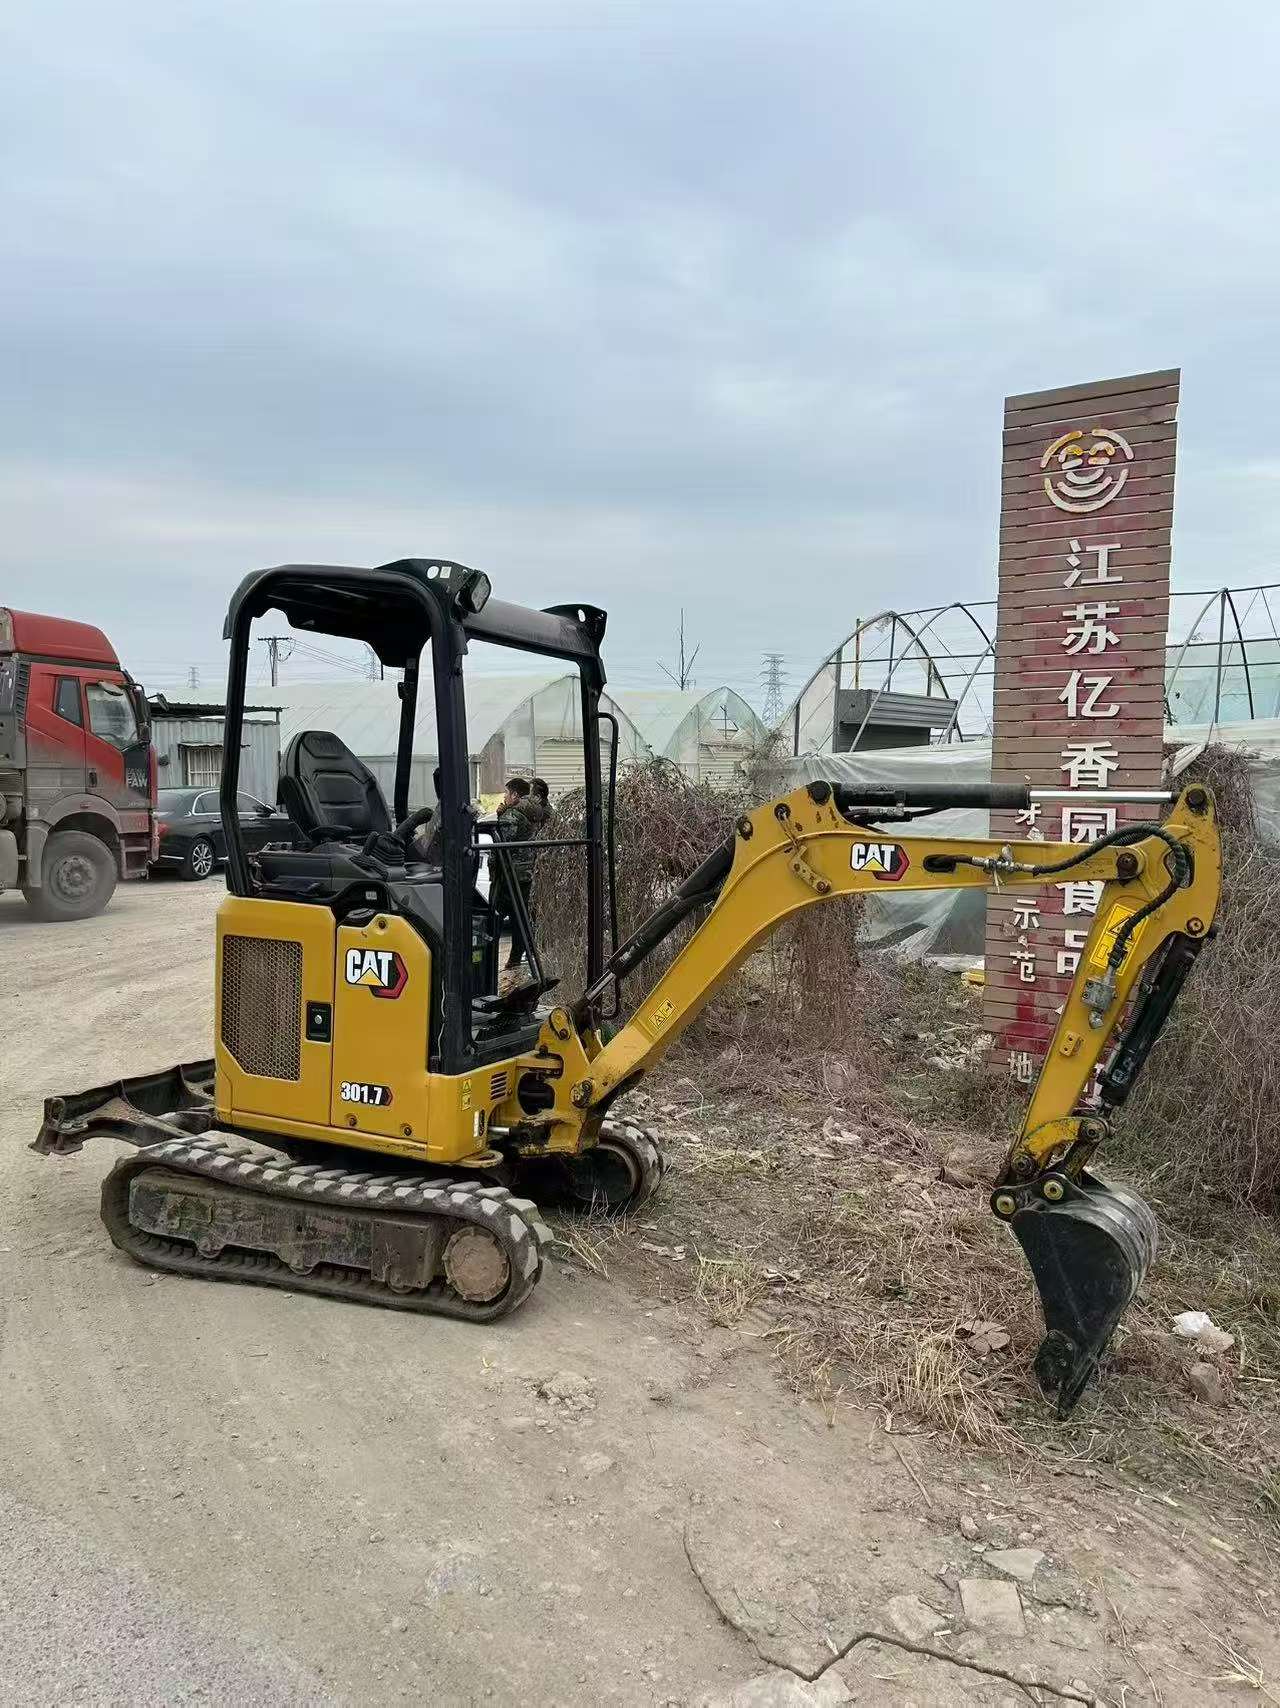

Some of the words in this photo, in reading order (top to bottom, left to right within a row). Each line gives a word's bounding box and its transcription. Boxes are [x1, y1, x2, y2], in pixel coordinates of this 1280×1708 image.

[1054, 539, 1122, 1105] 江苏亿香园食品
[851, 843, 895, 872] CAT
[346, 949, 393, 987] CAT
[341, 1081, 382, 1105] 301.7
